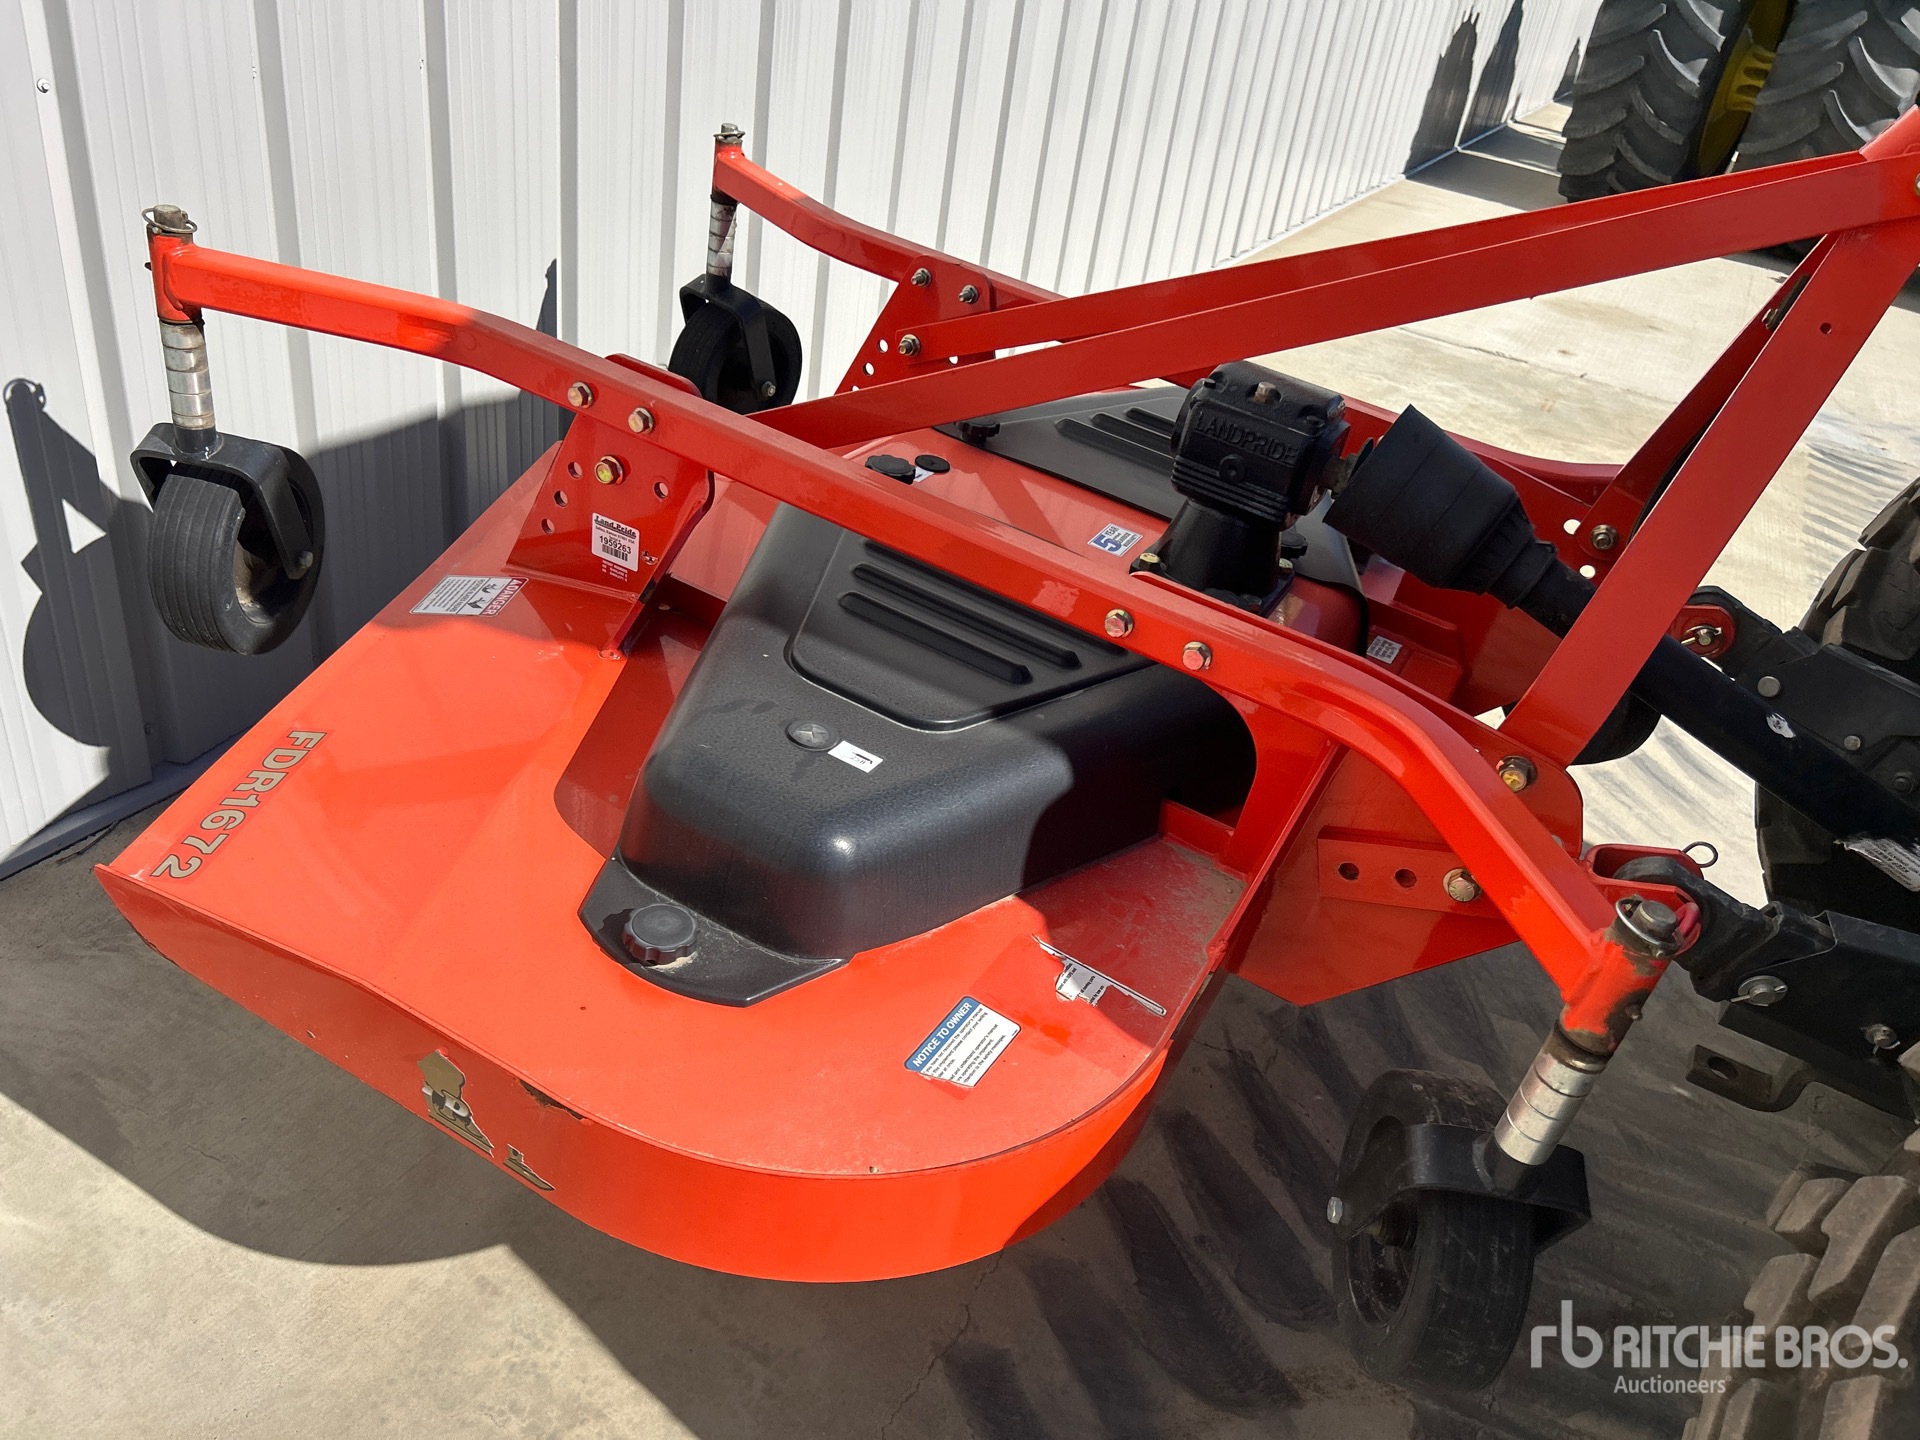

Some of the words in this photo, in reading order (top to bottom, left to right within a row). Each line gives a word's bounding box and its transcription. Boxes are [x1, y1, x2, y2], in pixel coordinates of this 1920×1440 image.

[1195, 411, 1300, 466] LANDPRIDE
[594, 516, 615, 529] Land
[616, 524, 636, 538] Pride
[1104, 526, 1120, 536] YEAR
[600, 535, 632, 554] 1959263
[1093, 534, 1122, 552] 5
[482, 585, 518, 615] DANGER
[150, 731, 327, 878] FDR1672
[912, 1038, 940, 1067] NOTICE
[936, 1028, 950, 1040] TO
[946, 1002, 973, 1029] OWNER
